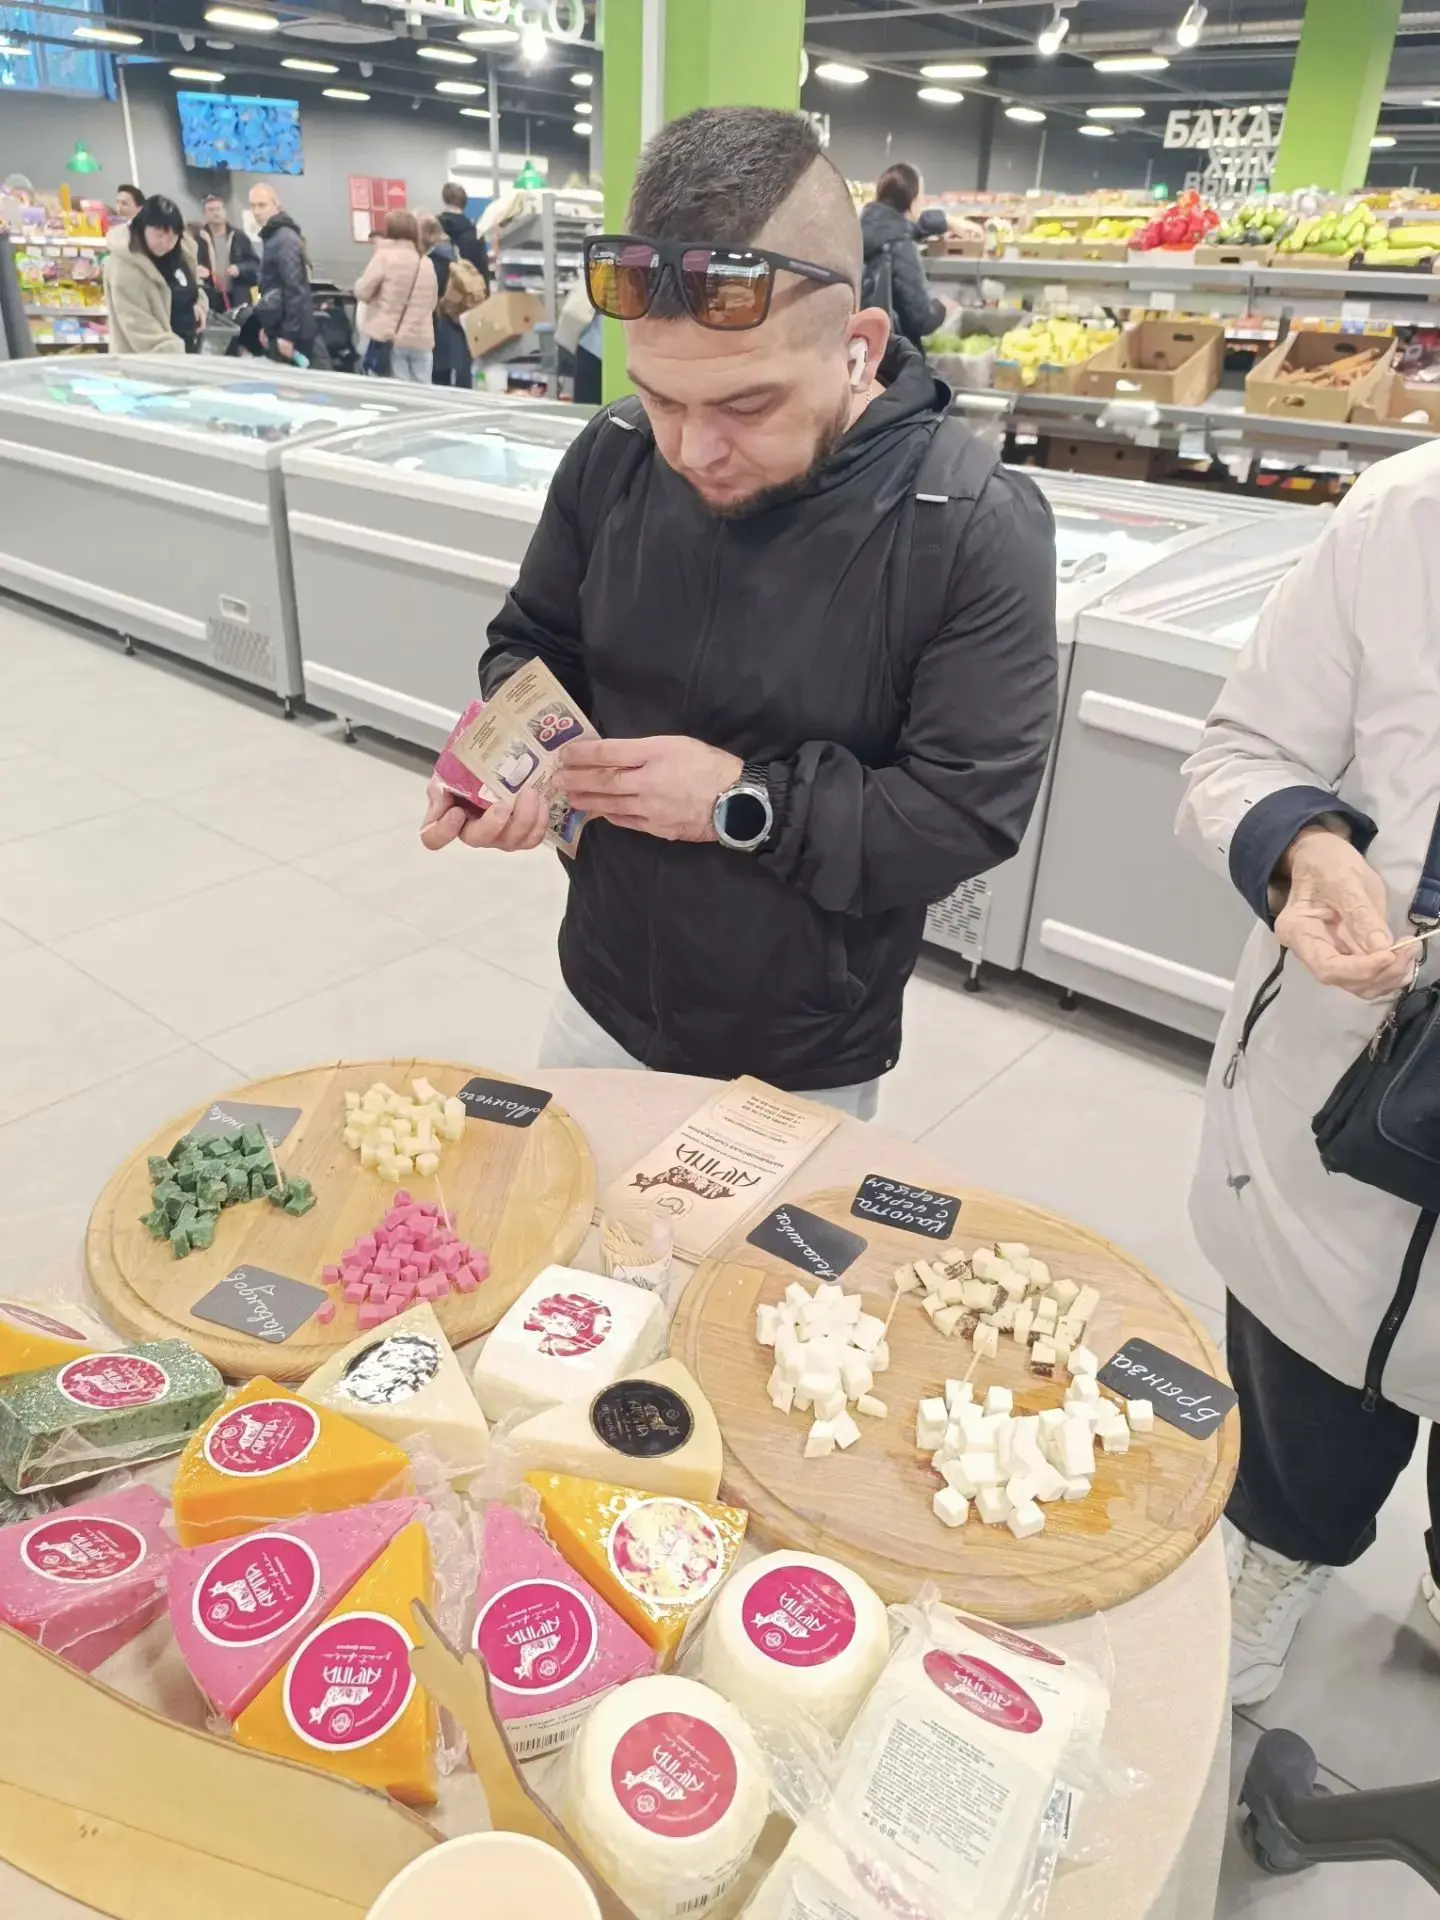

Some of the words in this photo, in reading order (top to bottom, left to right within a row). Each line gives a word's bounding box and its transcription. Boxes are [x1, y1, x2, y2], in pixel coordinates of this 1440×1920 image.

[458, 1090, 542, 1120] Манчего
[676, 1143, 761, 1187] ALPINA
[865, 1177, 953, 1208] перцем
[856, 1197, 947, 1234] Качотта
[1111, 1352, 1222, 1424] Брынза
[244, 1560, 279, 1610] ALPINA
[506, 1614, 561, 1646] ALPINA
[778, 1592, 827, 1633] ALPINA
[321, 1665, 383, 1686] ALPINA
[651, 1744, 706, 1792] ALPINA
